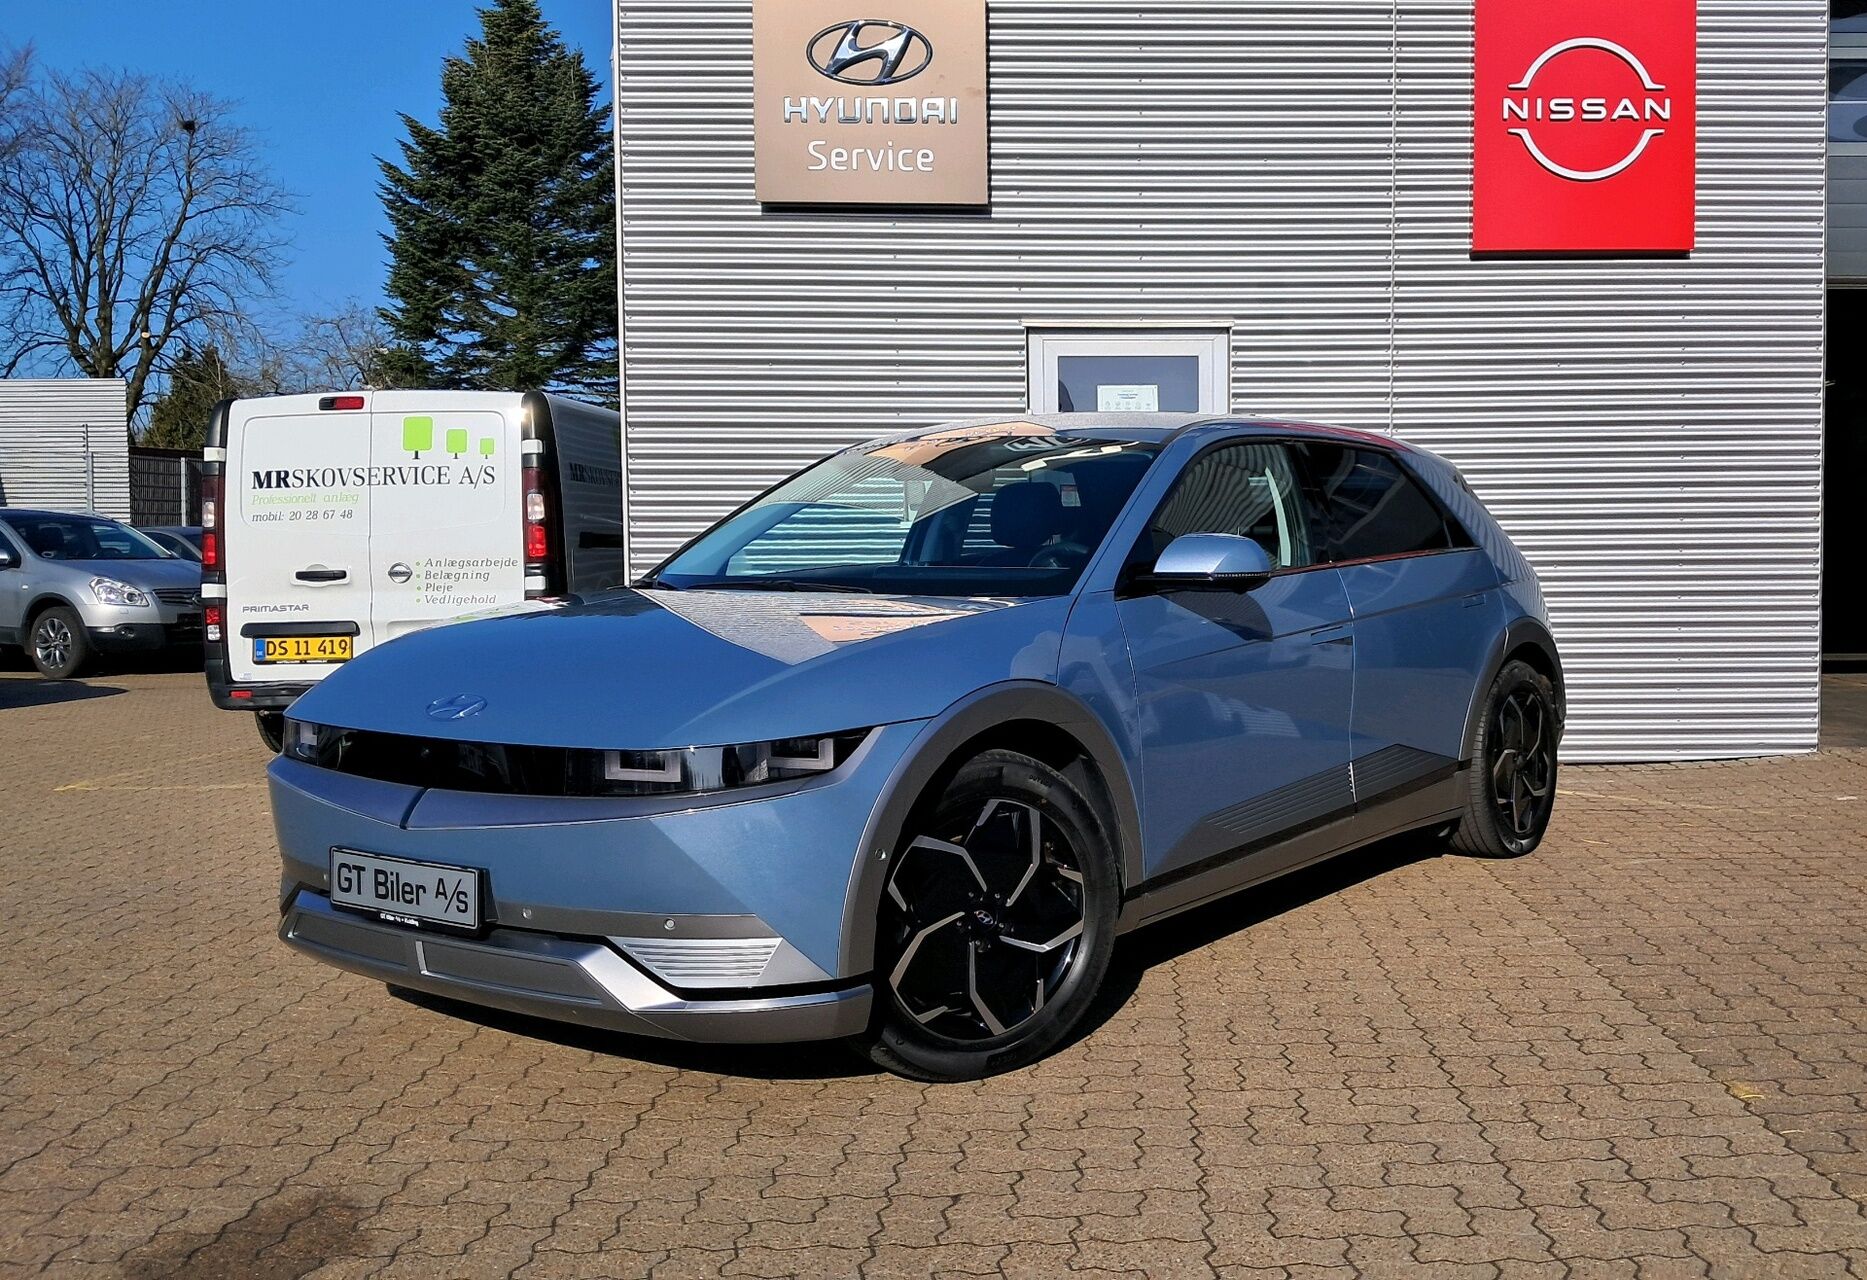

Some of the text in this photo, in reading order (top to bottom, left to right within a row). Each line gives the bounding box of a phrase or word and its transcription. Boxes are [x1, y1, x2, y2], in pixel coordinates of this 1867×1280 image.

[784, 97, 958, 124] HYUNDAI
[1502, 97, 1671, 121] NISSAN
[807, 140, 935, 171] Service
[251, 465, 496, 490] MRSKOVSERVICE A/S
[252, 509, 353, 522] mobil: 20 28 67 48
[424, 557, 519, 569] Anlægsarbejde
[424, 570, 490, 582] Belægning
[424, 582, 454, 594] Pleje
[424, 594, 497, 606] Vedligehold
[242, 604, 310, 613] PRIMASTAR
[266, 639, 348, 656] DS 11 419
[337, 862, 366, 895] GT
[374, 868, 427, 906] Biler
